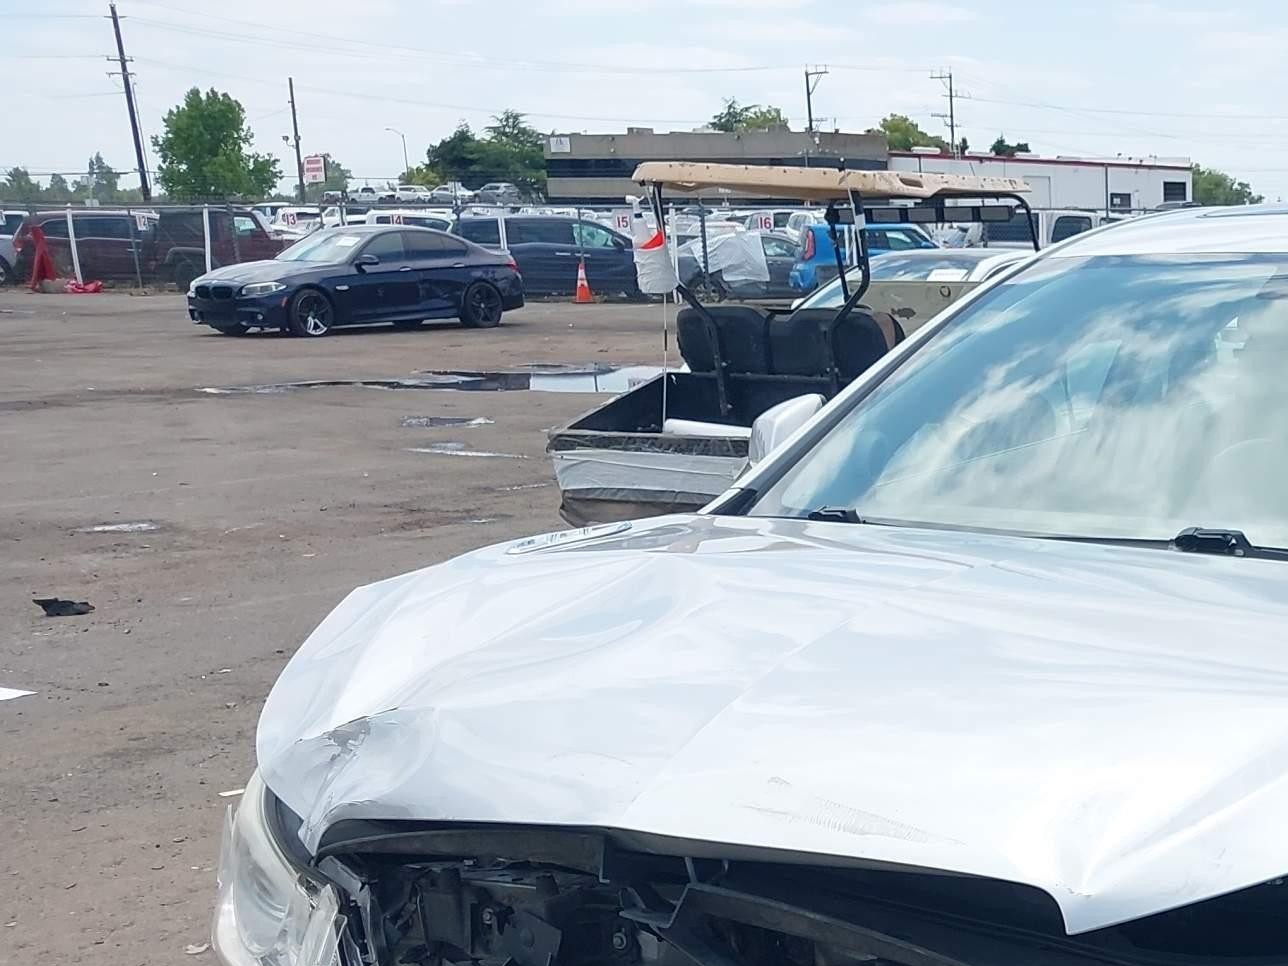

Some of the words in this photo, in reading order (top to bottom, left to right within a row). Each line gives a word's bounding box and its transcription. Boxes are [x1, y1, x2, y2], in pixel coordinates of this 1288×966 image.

[286, 213, 296, 225] 13
[391, 214, 401, 225] 14
[617, 216, 629, 228] 15
[760, 217, 772, 229] 16
